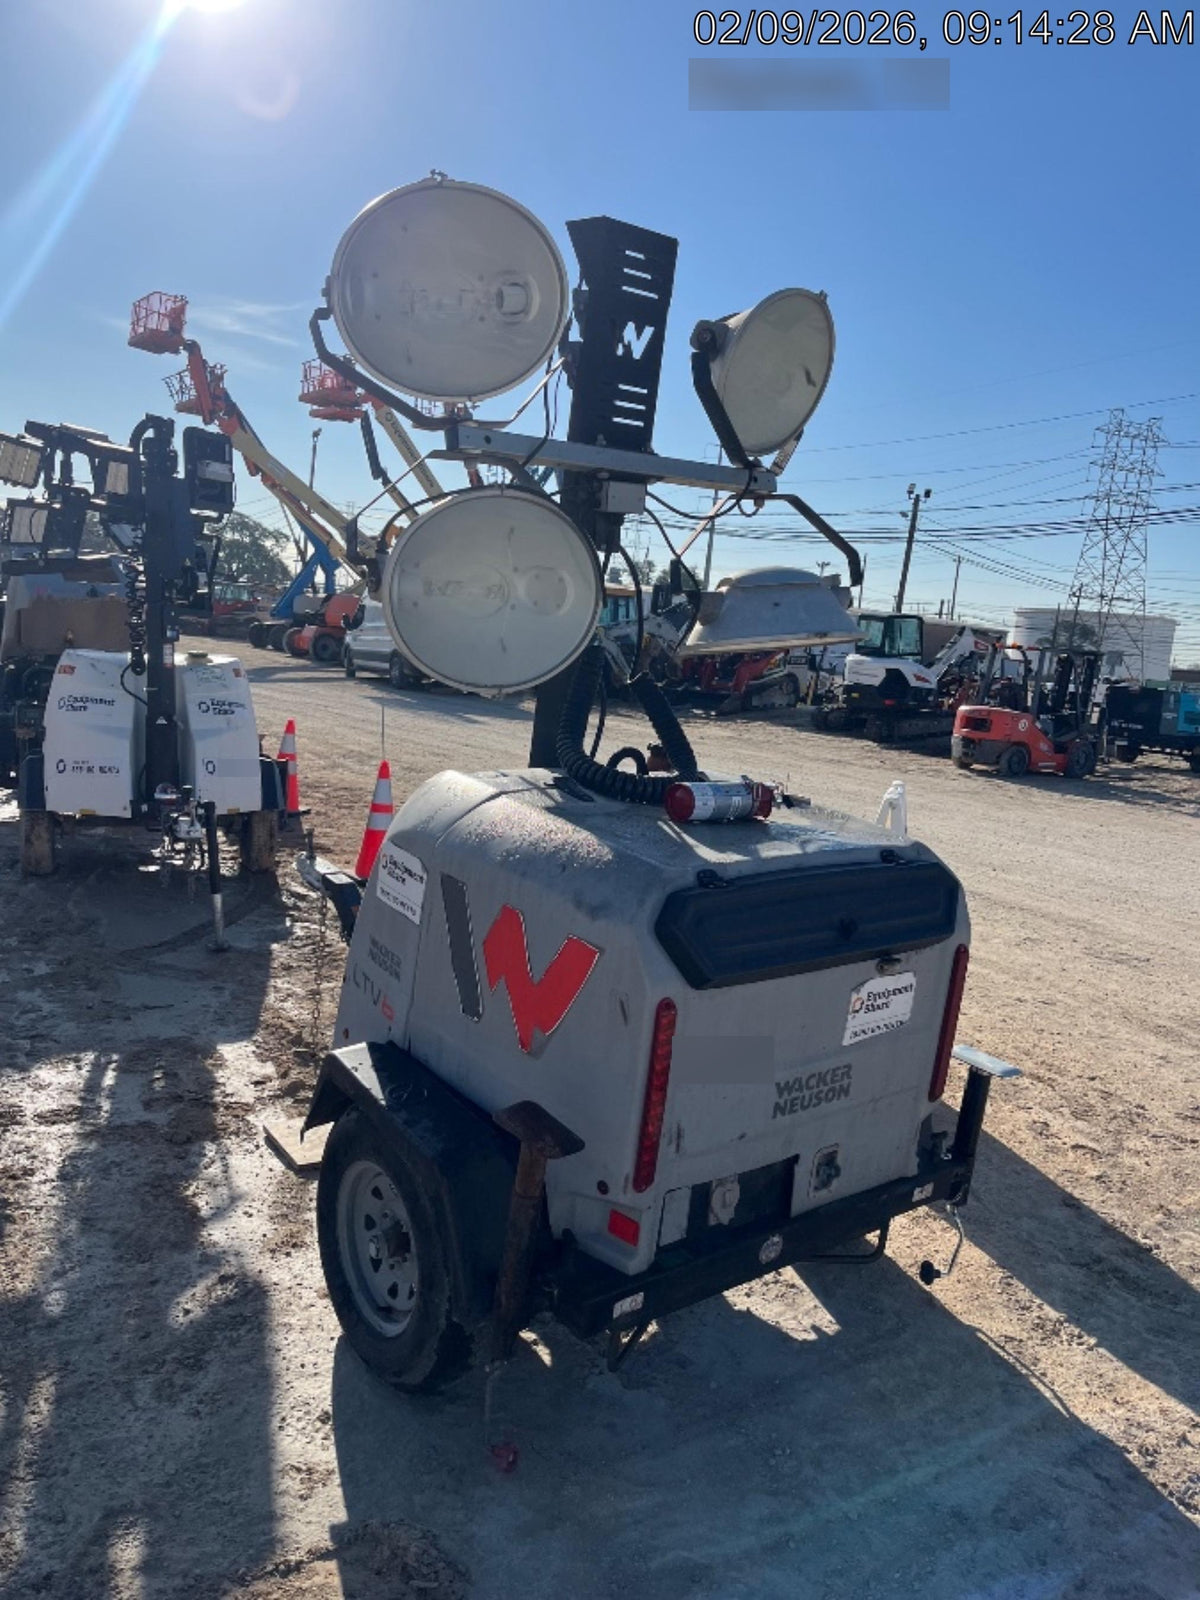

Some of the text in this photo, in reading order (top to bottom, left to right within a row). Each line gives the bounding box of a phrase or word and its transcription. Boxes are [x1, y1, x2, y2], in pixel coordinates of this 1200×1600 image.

[864, 999, 891, 1014] Share
[867, 983, 914, 1003] Equipment
[774, 1063, 853, 1100] WACKER
[771, 1082, 852, 1120] NEUSON
